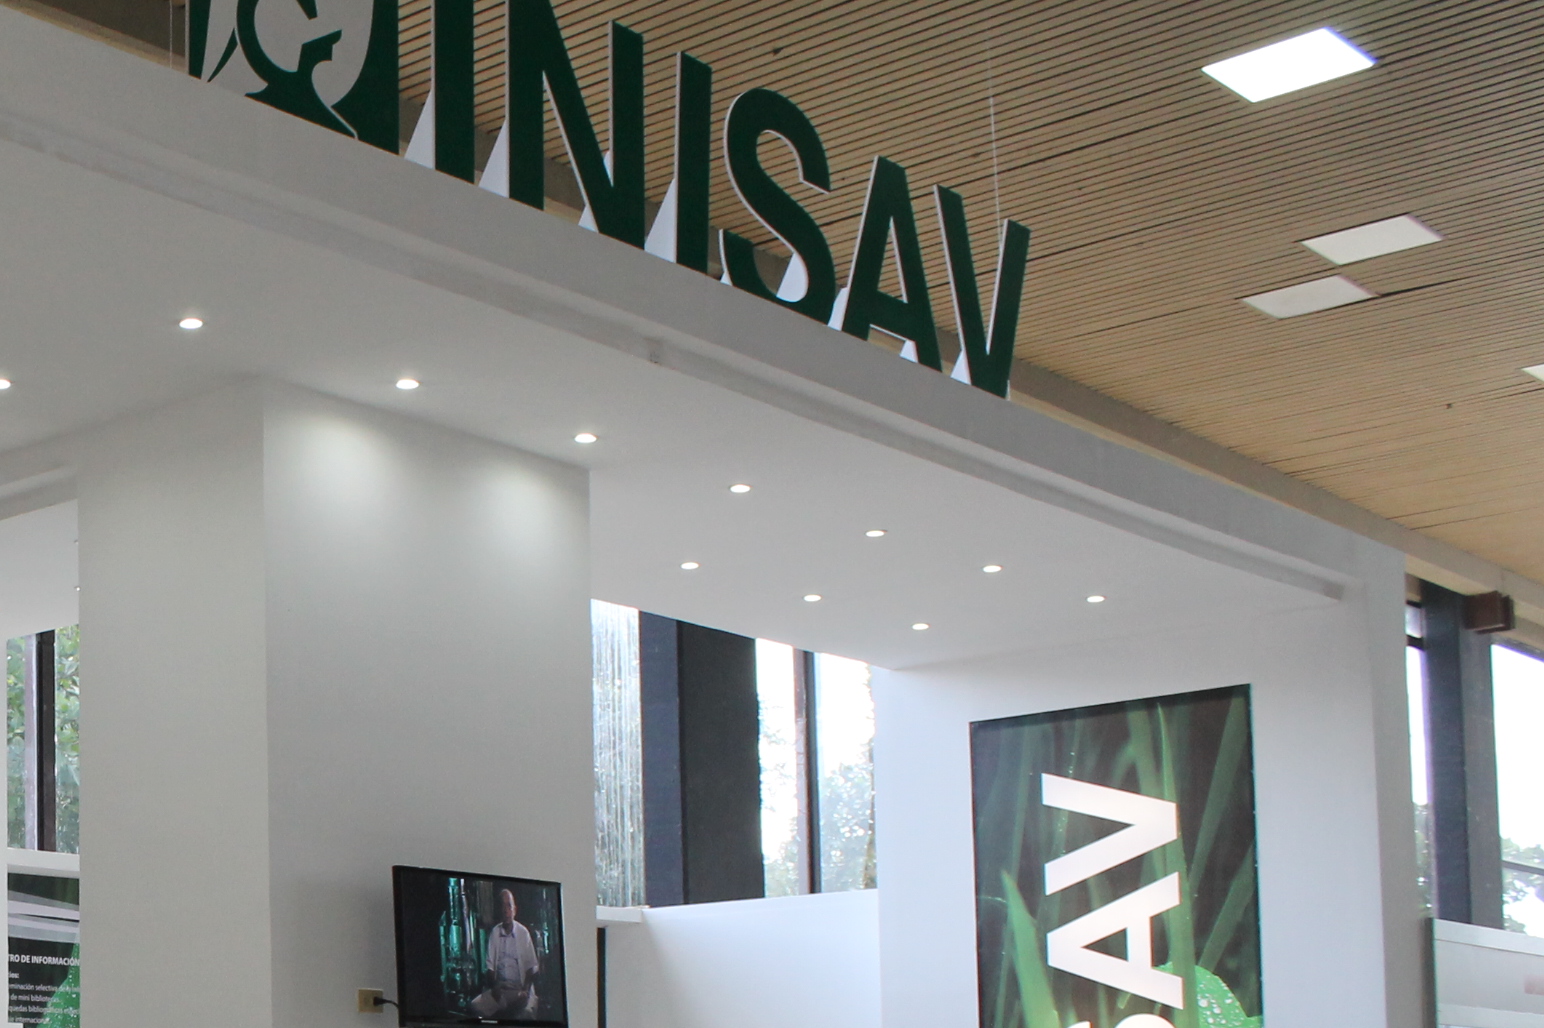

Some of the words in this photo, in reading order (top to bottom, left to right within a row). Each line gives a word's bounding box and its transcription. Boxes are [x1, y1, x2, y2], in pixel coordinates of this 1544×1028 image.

[431, 0, 1031, 399] INISAV
[21, 955, 30, 963] DE
[32, 955, 80, 966] INFORMACIÓN
